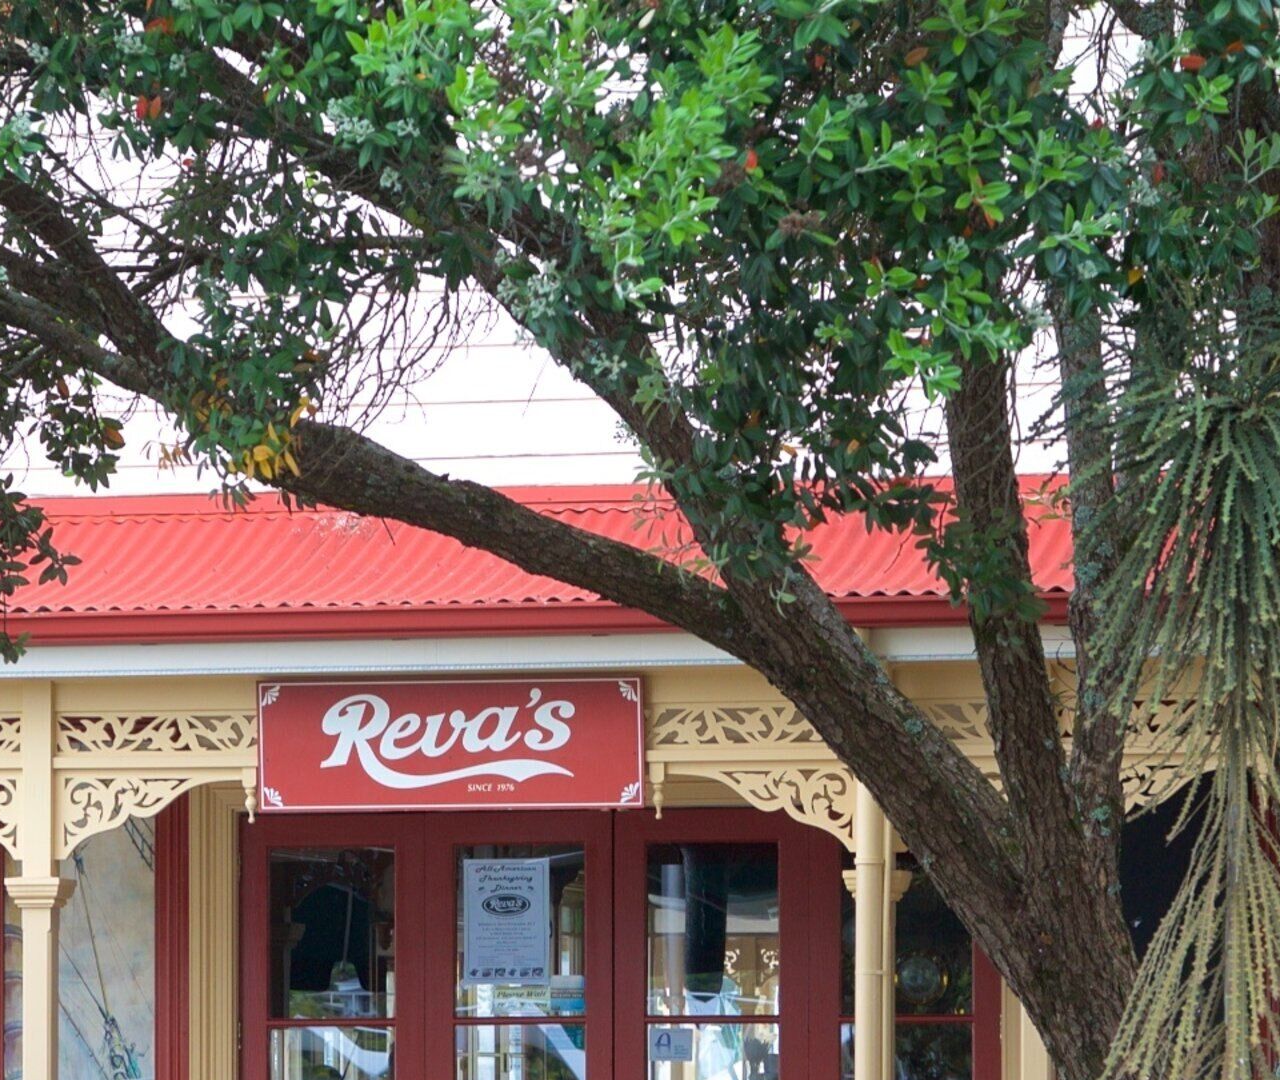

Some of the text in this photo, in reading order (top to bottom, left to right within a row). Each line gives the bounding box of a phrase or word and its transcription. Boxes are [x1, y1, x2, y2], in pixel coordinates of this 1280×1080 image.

[320, 688, 576, 788] Reva's
[467, 784, 515, 792] SINCE 1976
[655, 1032, 671, 1053] A
